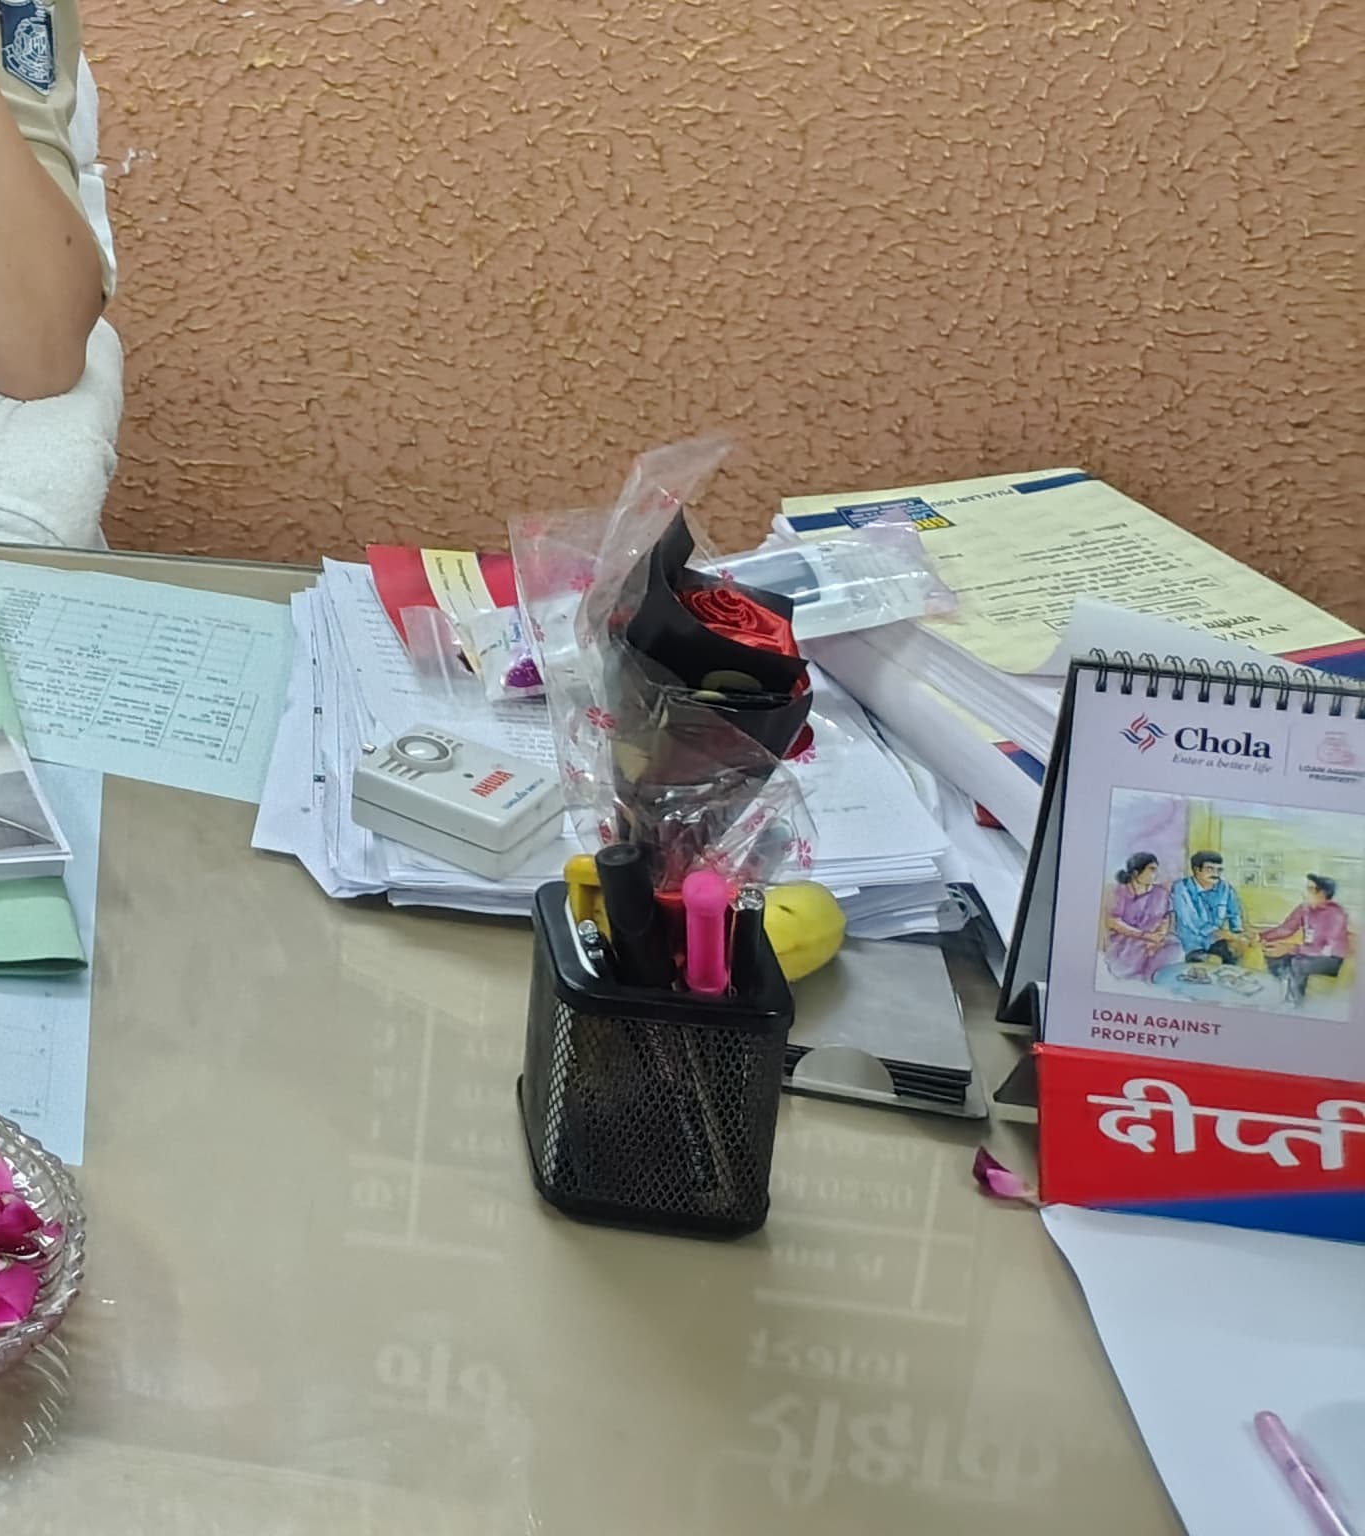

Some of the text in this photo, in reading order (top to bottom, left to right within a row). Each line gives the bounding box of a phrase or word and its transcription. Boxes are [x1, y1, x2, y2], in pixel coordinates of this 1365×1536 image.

[1174, 727, 1273, 760] Chola
[470, 769, 515, 798] AHUJA
[1092, 1009, 1222, 1036] LOAN AGAINST
[1090, 1026, 1179, 1050] PROPERTY
